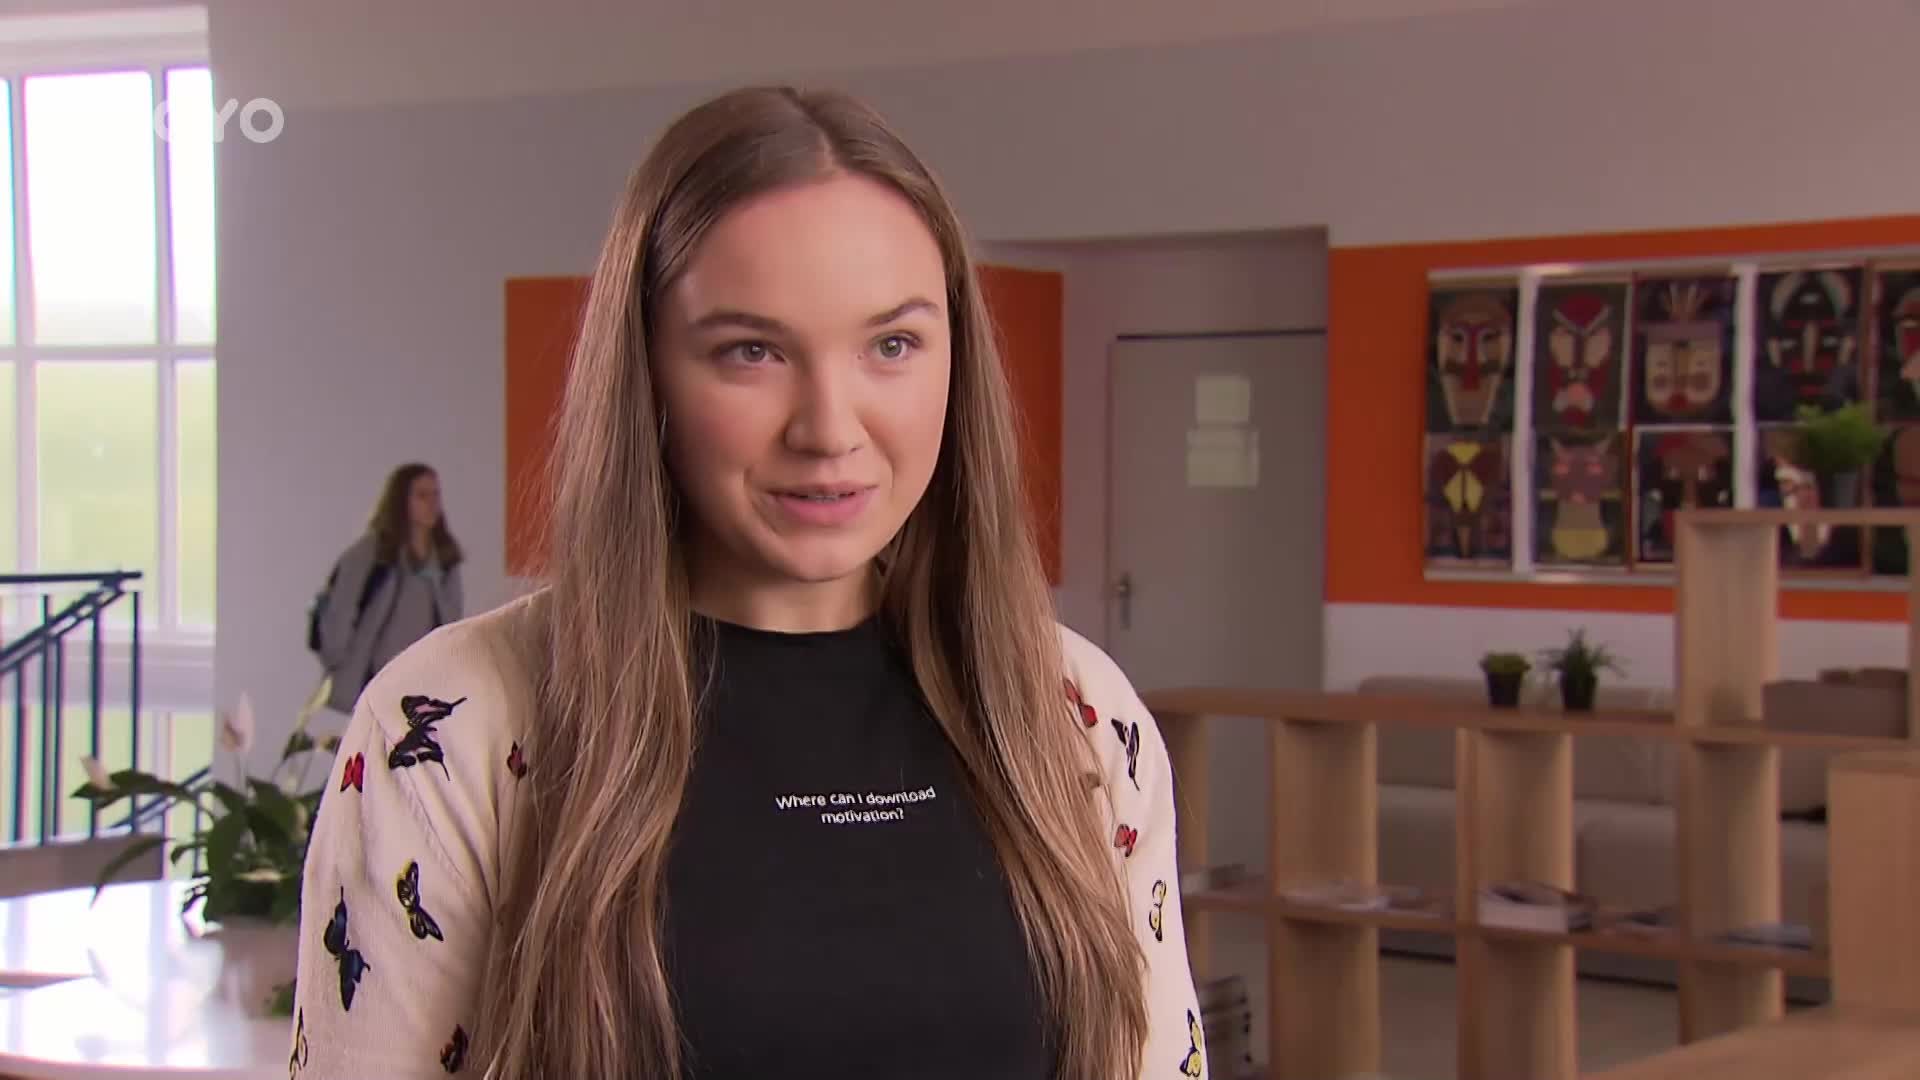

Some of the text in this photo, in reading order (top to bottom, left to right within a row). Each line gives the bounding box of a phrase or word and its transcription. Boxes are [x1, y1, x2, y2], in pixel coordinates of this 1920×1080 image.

[775, 792, 826, 810] Where
[829, 792, 855, 805] can
[866, 785, 937, 806] download
[821, 807, 905, 824] motivation?
